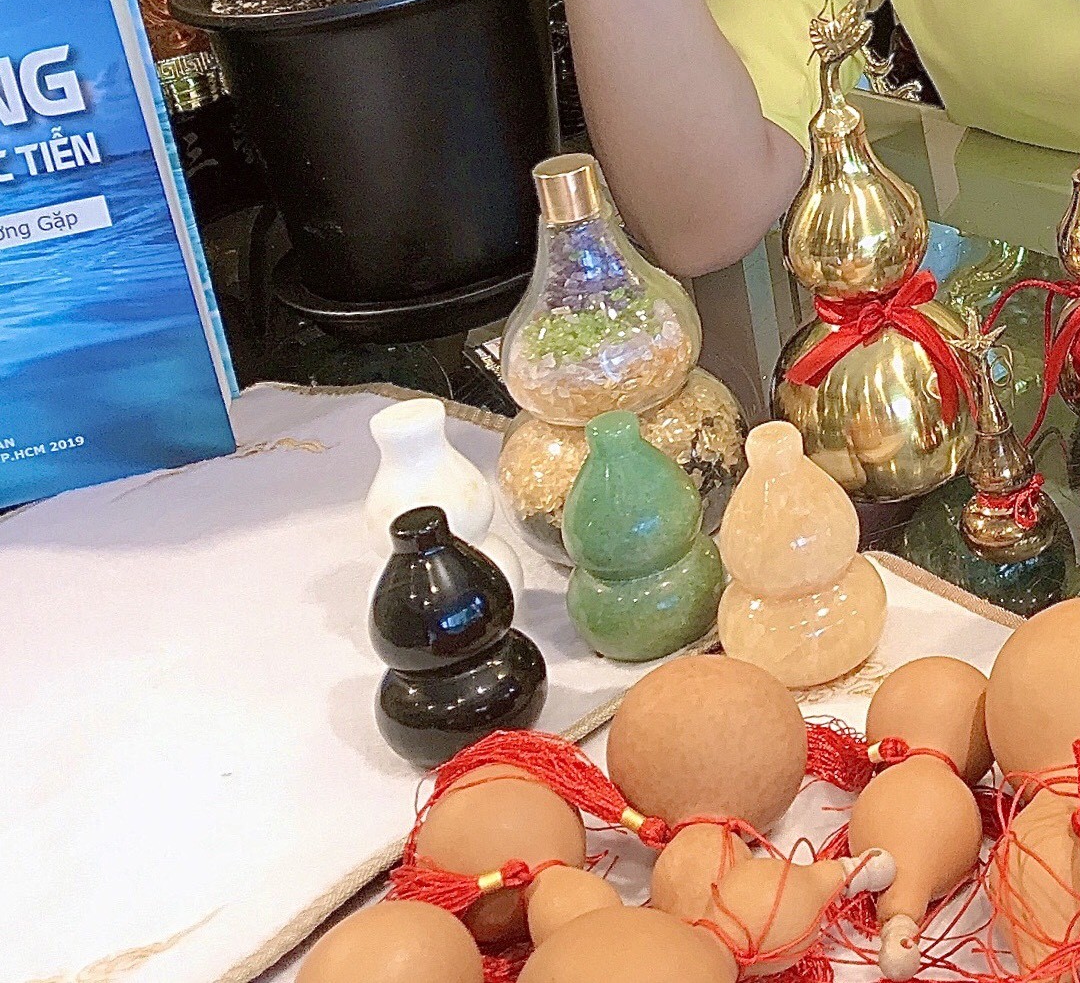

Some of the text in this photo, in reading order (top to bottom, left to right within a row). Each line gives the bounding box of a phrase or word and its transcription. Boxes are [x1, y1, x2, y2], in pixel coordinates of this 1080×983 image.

[14, 125, 101, 176] TIỄN
[37, 211, 78, 231] Gặp
[0, 436, 84, 463] P.HCM 2019
